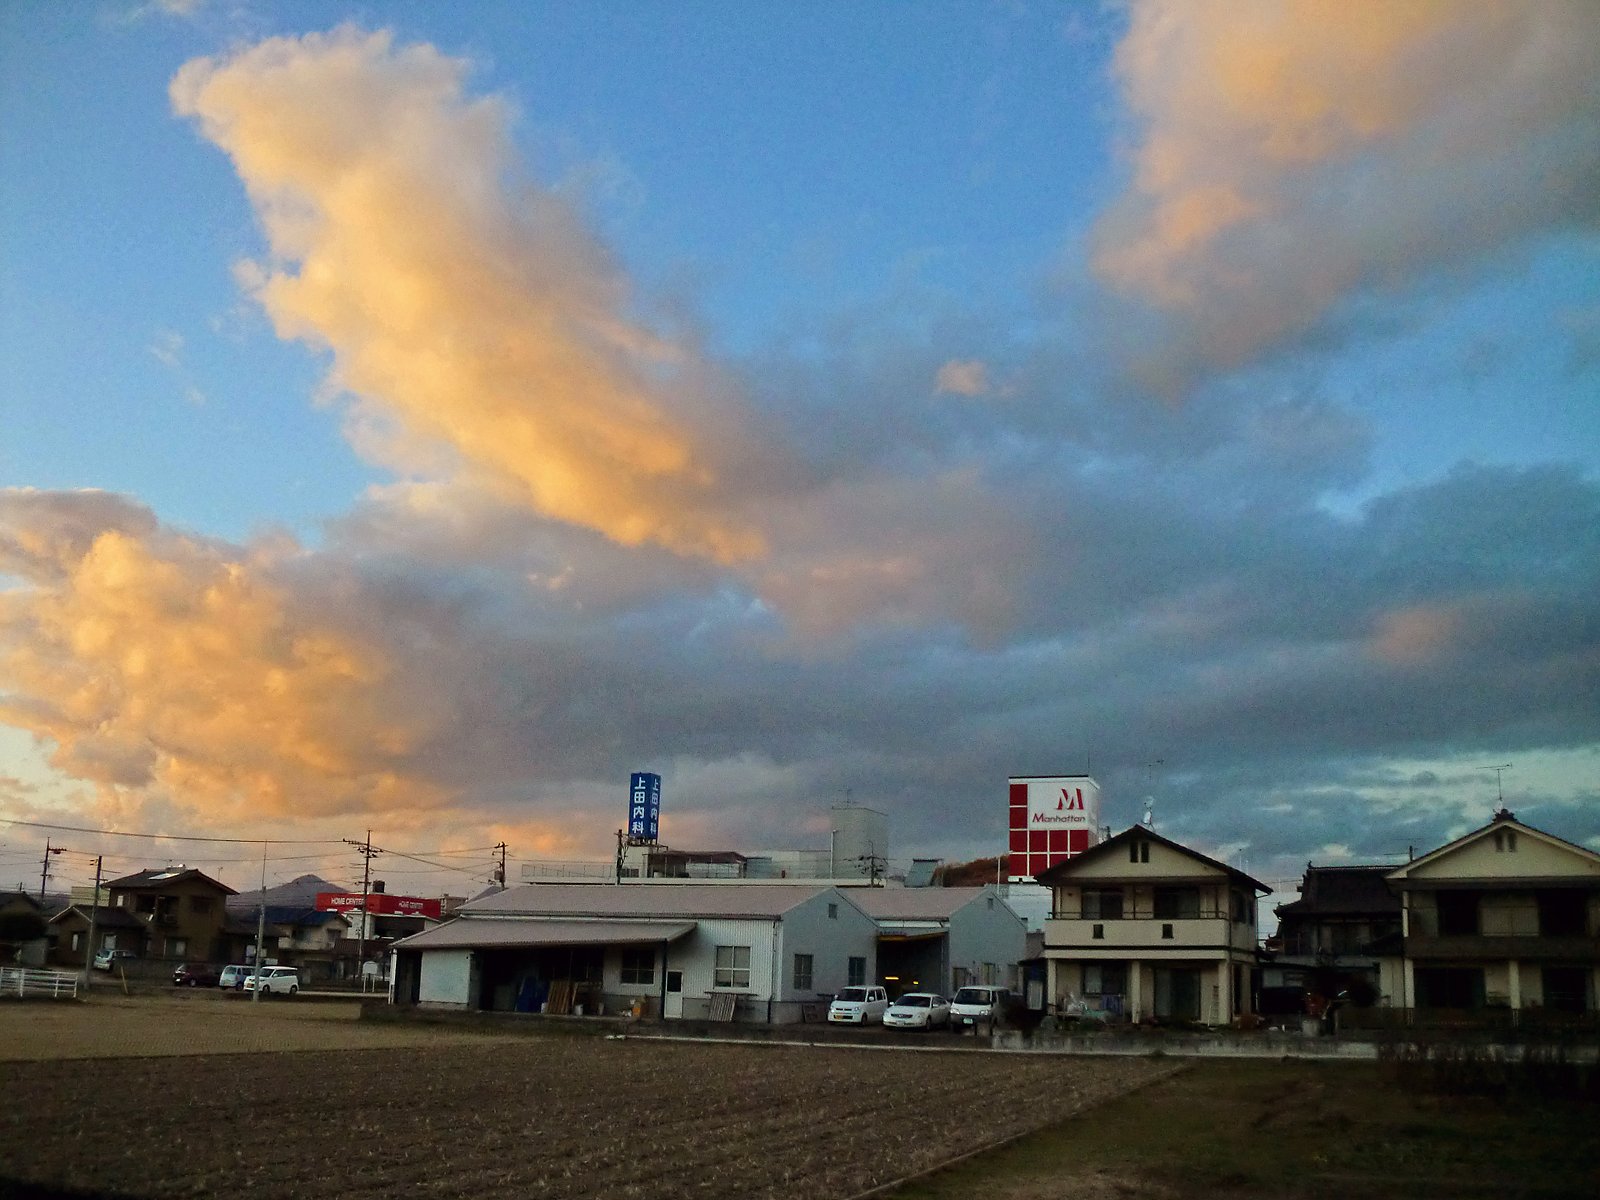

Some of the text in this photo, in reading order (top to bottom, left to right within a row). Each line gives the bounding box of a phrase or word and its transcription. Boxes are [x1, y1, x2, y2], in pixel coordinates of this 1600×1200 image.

[632, 777, 646, 834] 上田内科
[1032, 812, 1086, 823] Manhattan
[331, 897, 345, 905] HOME
